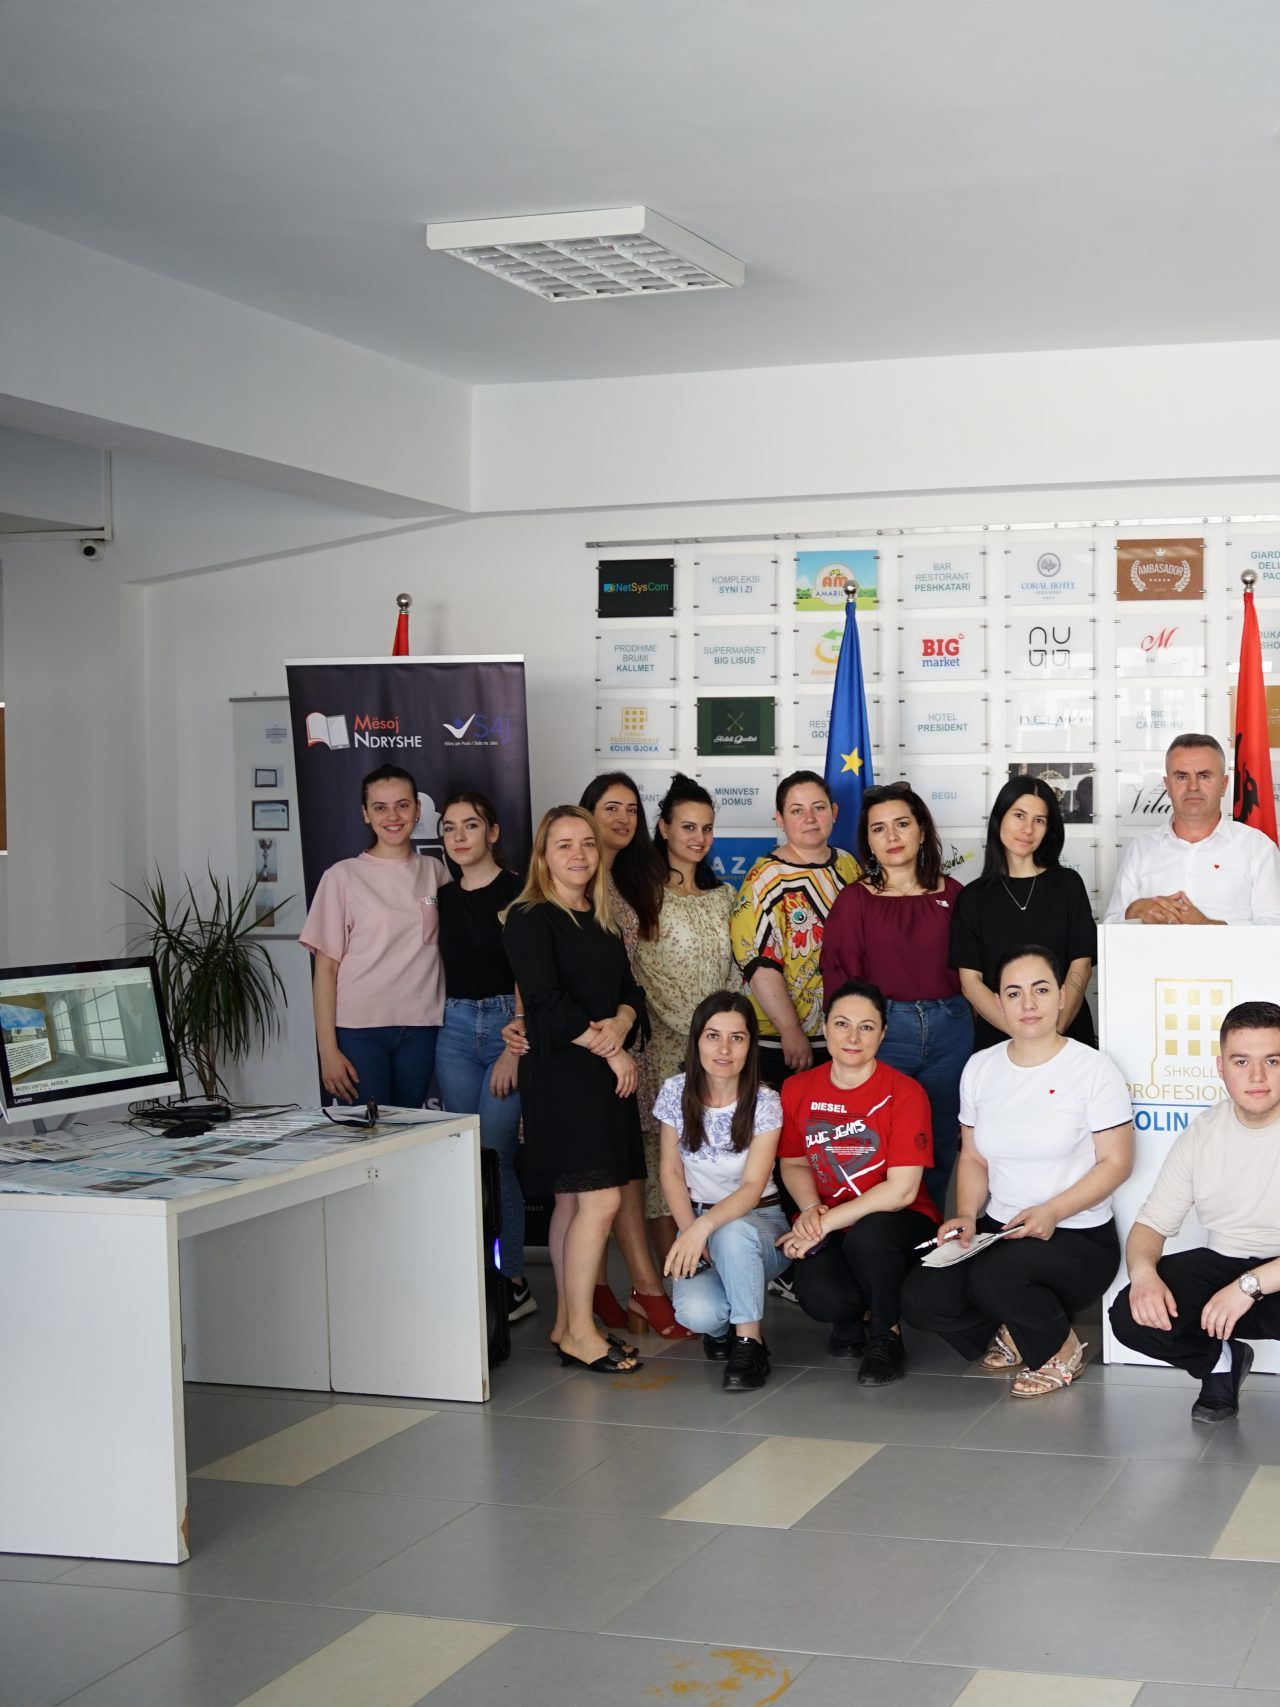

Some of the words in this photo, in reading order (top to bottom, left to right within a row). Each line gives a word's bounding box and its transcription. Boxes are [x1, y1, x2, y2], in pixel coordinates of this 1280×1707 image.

[1138, 564, 1184, 576] AMBASADOR
[712, 576, 760, 584] KOMPLEKSI
[915, 572, 970, 582] RESTORANT
[616, 583, 668, 593] NetSysCom
[914, 583, 970, 592] PESHKATARI
[1050, 581, 1075, 589] HOTEL
[719, 586, 739, 594] SYNI
[614, 644, 657, 652] PRODHIME
[704, 646, 766, 655] SUPERMARKET
[922, 638, 960, 656] BIG
[622, 654, 648, 662] BRUMI
[714, 656, 729, 664] BIG
[731, 656, 756, 664] LISUS
[922, 656, 960, 668] market
[616, 664, 655, 672] KALLMET
[928, 713, 958, 722] HOTEL
[354, 715, 399, 734] Mësoj
[918, 723, 968, 732] PRESIDENT
[354, 732, 422, 748] NDRYSHE
[714, 788, 760, 796] MININVEST
[932, 792, 957, 800] BEGU
[722, 798, 752, 806] DOMUS
[1126, 784, 1172, 814] Vila
[1164, 1066, 1219, 1079] SHKOLL
[1126, 1083, 1231, 1101] ROFESION
[810, 1102, 848, 1114] DIESEL
[1134, 1110, 1189, 1132] OLIN
[832, 1120, 866, 1140] JEANS
